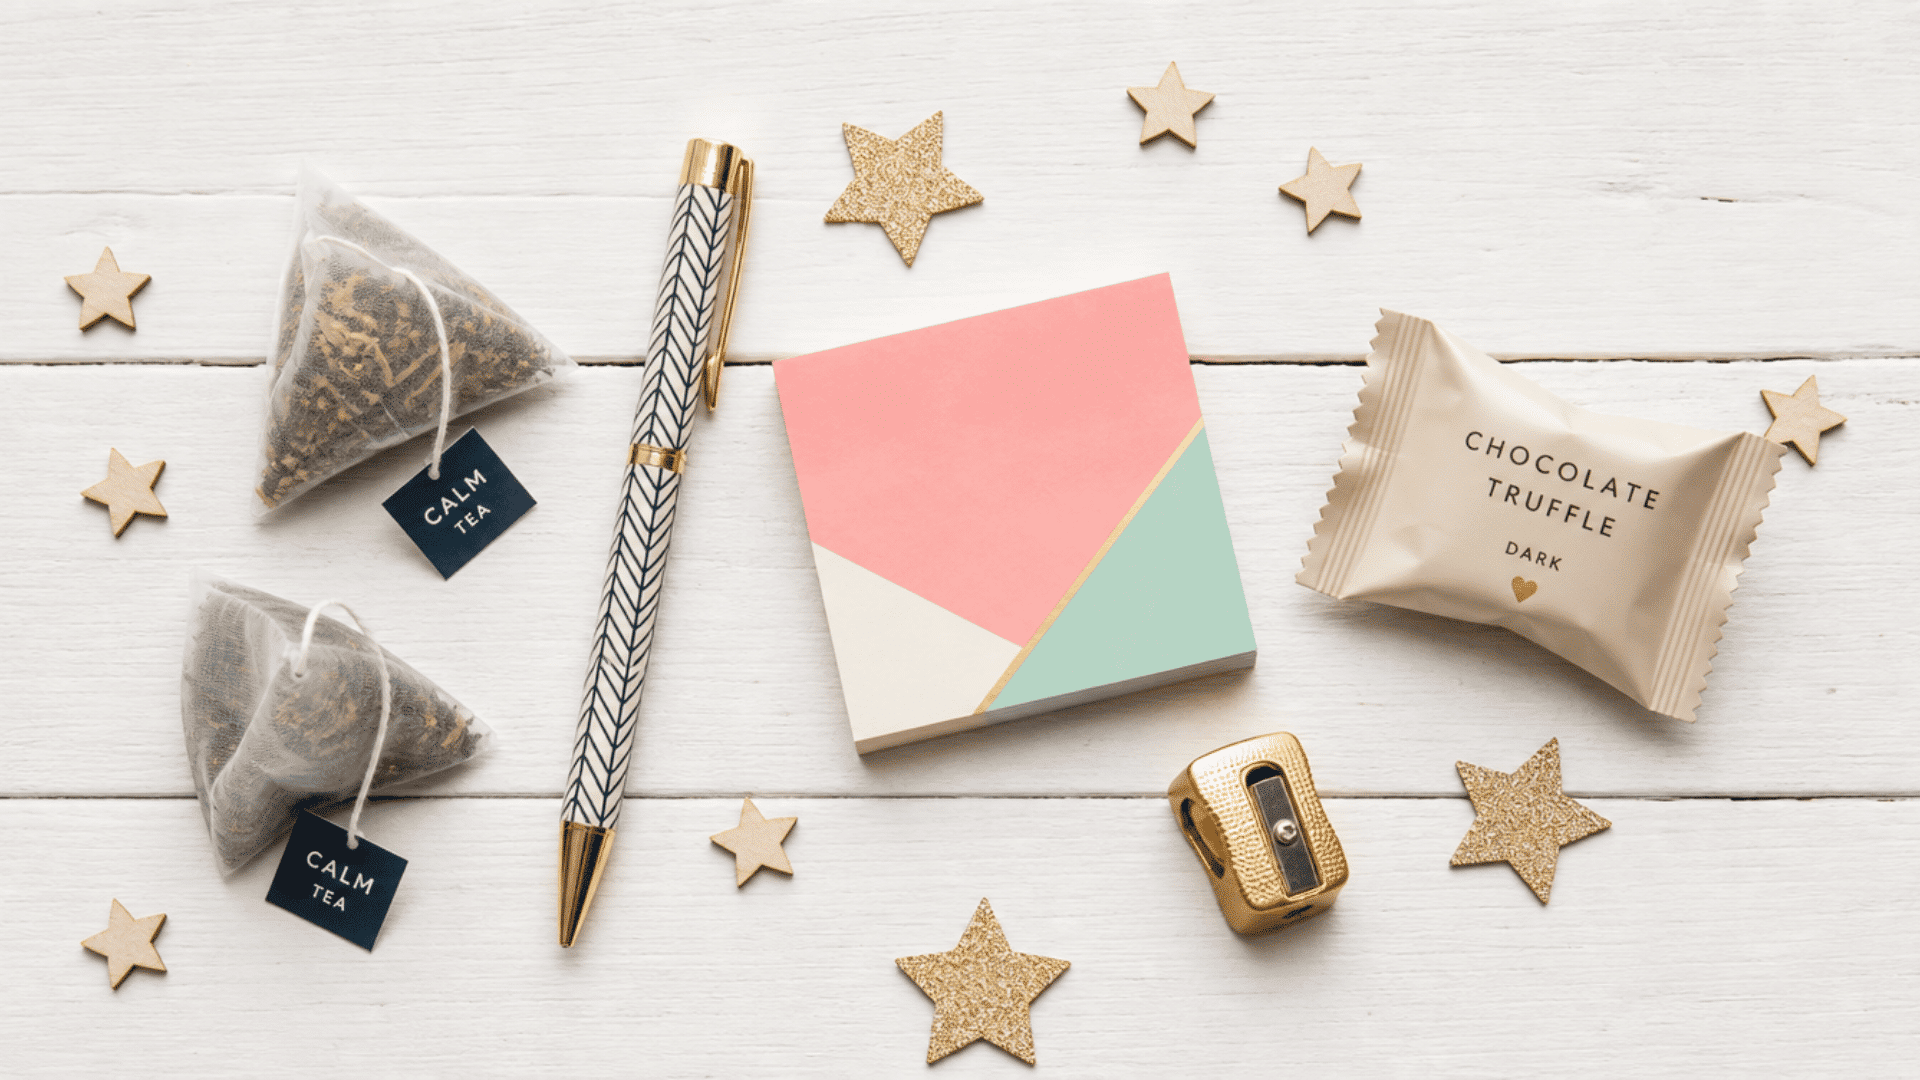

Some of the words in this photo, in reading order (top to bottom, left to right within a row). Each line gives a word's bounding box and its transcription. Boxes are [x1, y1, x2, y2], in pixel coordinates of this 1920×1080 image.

[1465, 431, 1660, 511] CHOCOLATE
[424, 468, 487, 525] CALM
[453, 504, 491, 534] TEA
[1488, 477, 1616, 538] TRUFFLE
[1505, 541, 1562, 571] DARK
[306, 850, 375, 896] CALM
[312, 883, 345, 912] TEA
